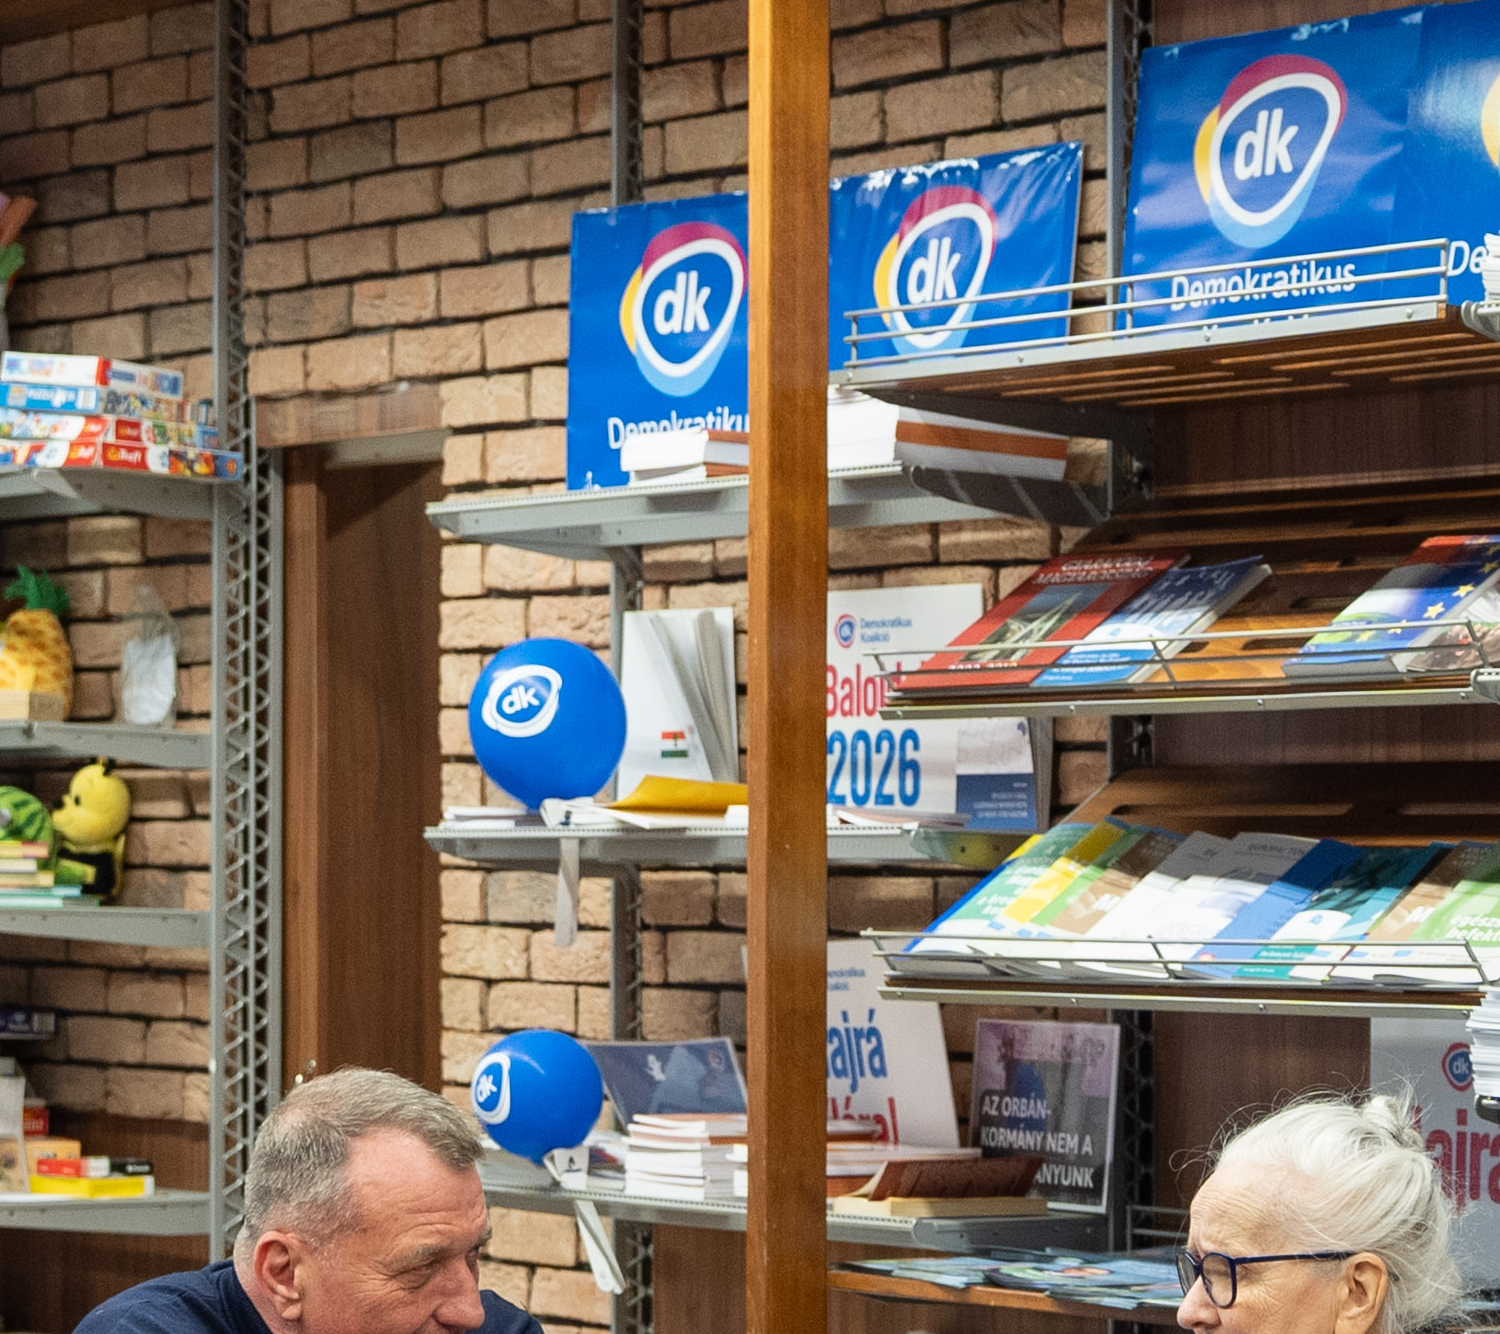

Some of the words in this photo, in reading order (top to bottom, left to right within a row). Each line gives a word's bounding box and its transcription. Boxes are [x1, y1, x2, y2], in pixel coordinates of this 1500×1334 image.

[1233, 109, 1300, 181] dk
[906, 235, 958, 305] dk
[1170, 259, 1357, 312] Demokratikus
[653, 270, 710, 336] dk
[607, 405, 749, 450] Demokratiku
[501, 685, 540, 716] dk
[827, 728, 921, 807] 2026
[827, 1007, 889, 1094] ajrá
[476, 1073, 498, 1104] dk
[982, 1095, 999, 1117] AZ
[1001, 1092, 1052, 1119] ORBÁN-
[982, 1124, 1045, 1152] KORMÁNY
[1045, 1131, 1080, 1156] NEM
[1081, 1134, 1093, 1156] A
